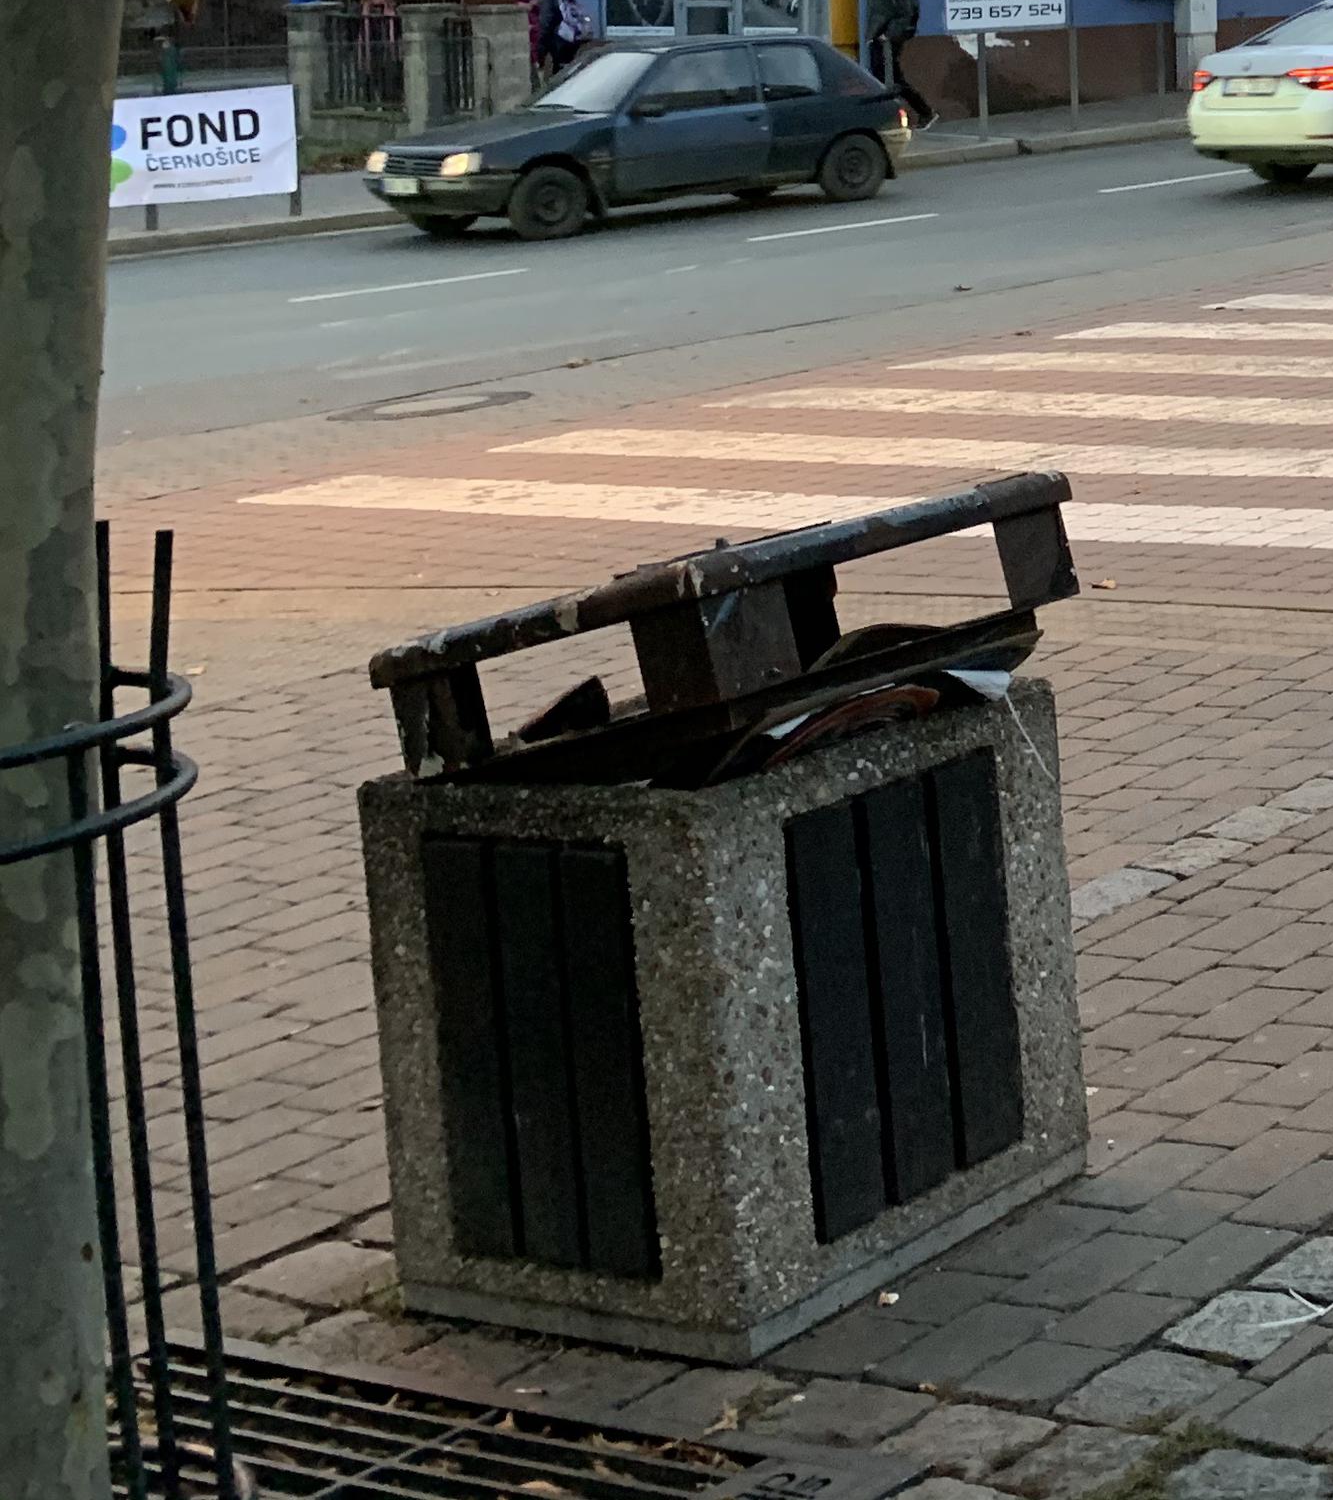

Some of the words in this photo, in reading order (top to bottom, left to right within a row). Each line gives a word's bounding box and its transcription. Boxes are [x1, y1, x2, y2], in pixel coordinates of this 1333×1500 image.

[950, 6, 983, 21] 739
[989, 5, 1022, 19] 657
[1028, 3, 1063, 17] 524
[139, 108, 261, 151] FOND
[146, 146, 261, 172] ČERNOŠICE
